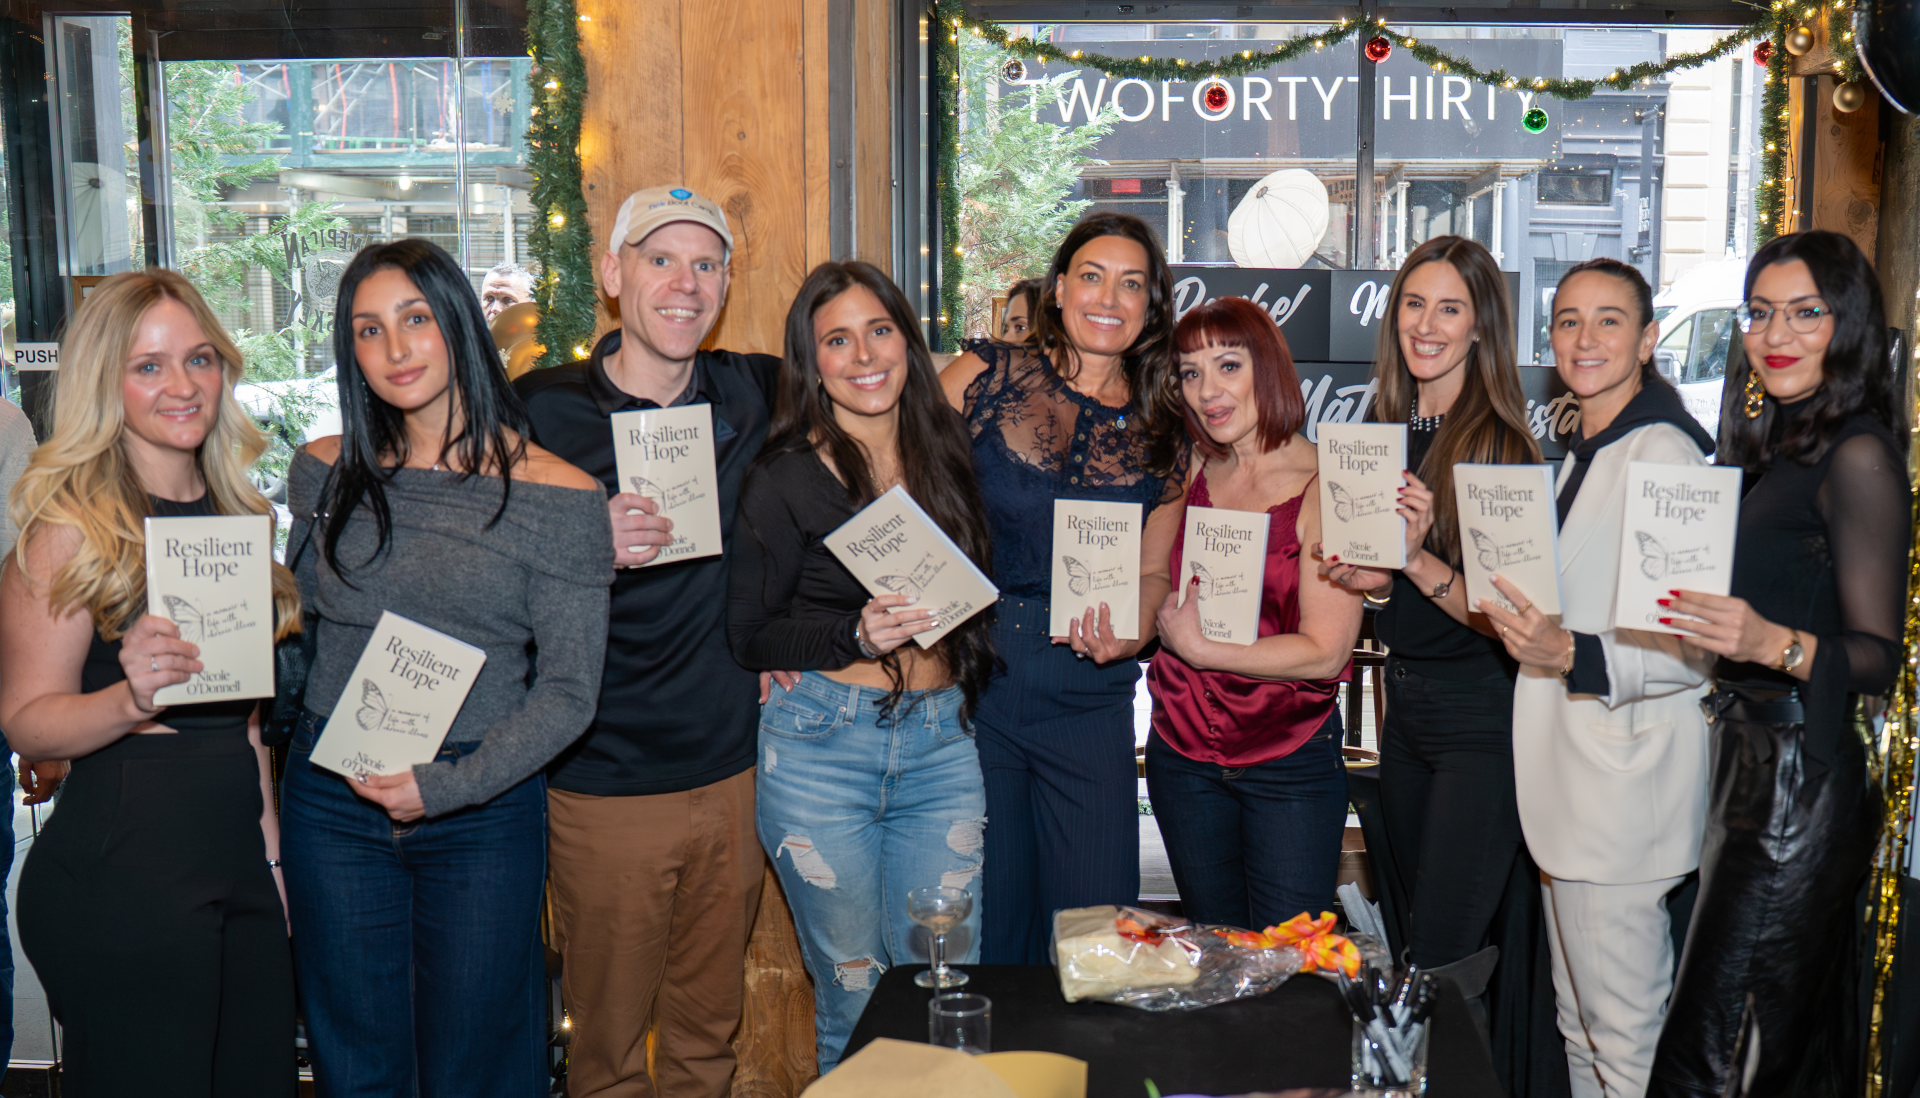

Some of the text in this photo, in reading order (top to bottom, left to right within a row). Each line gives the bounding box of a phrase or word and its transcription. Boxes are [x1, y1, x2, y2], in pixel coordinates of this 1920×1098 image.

[1019, 76, 1537, 122] TWOFORTYHIRTY
[15, 350, 58, 363] PUSH
[629, 426, 700, 446] Resilient
[644, 444, 690, 463] Hope
[1329, 439, 1389, 457] Resilient
[1340, 456, 1379, 476] Hope
[1468, 484, 1534, 502] Resilient
[1642, 480, 1722, 504] Resilient
[1481, 501, 1524, 522] Hope
[1654, 501, 1706, 526] Hope
[1067, 515, 1130, 532] Resilient
[1196, 522, 1253, 541] Resilient
[846, 514, 906, 558] Resilient
[1078, 531, 1118, 550] Hope
[165, 537, 253, 558] Resilient
[866, 531, 908, 562] Hope
[1204, 537, 1242, 557] Hope
[182, 558, 239, 582] Hope
[1202, 627, 1232, 639] 'Donnell
[1204, 619, 1226, 630] Nicole
[385, 636, 461, 681] Resilient
[197, 670, 230, 685] Nicole
[390, 658, 440, 691] Hope
